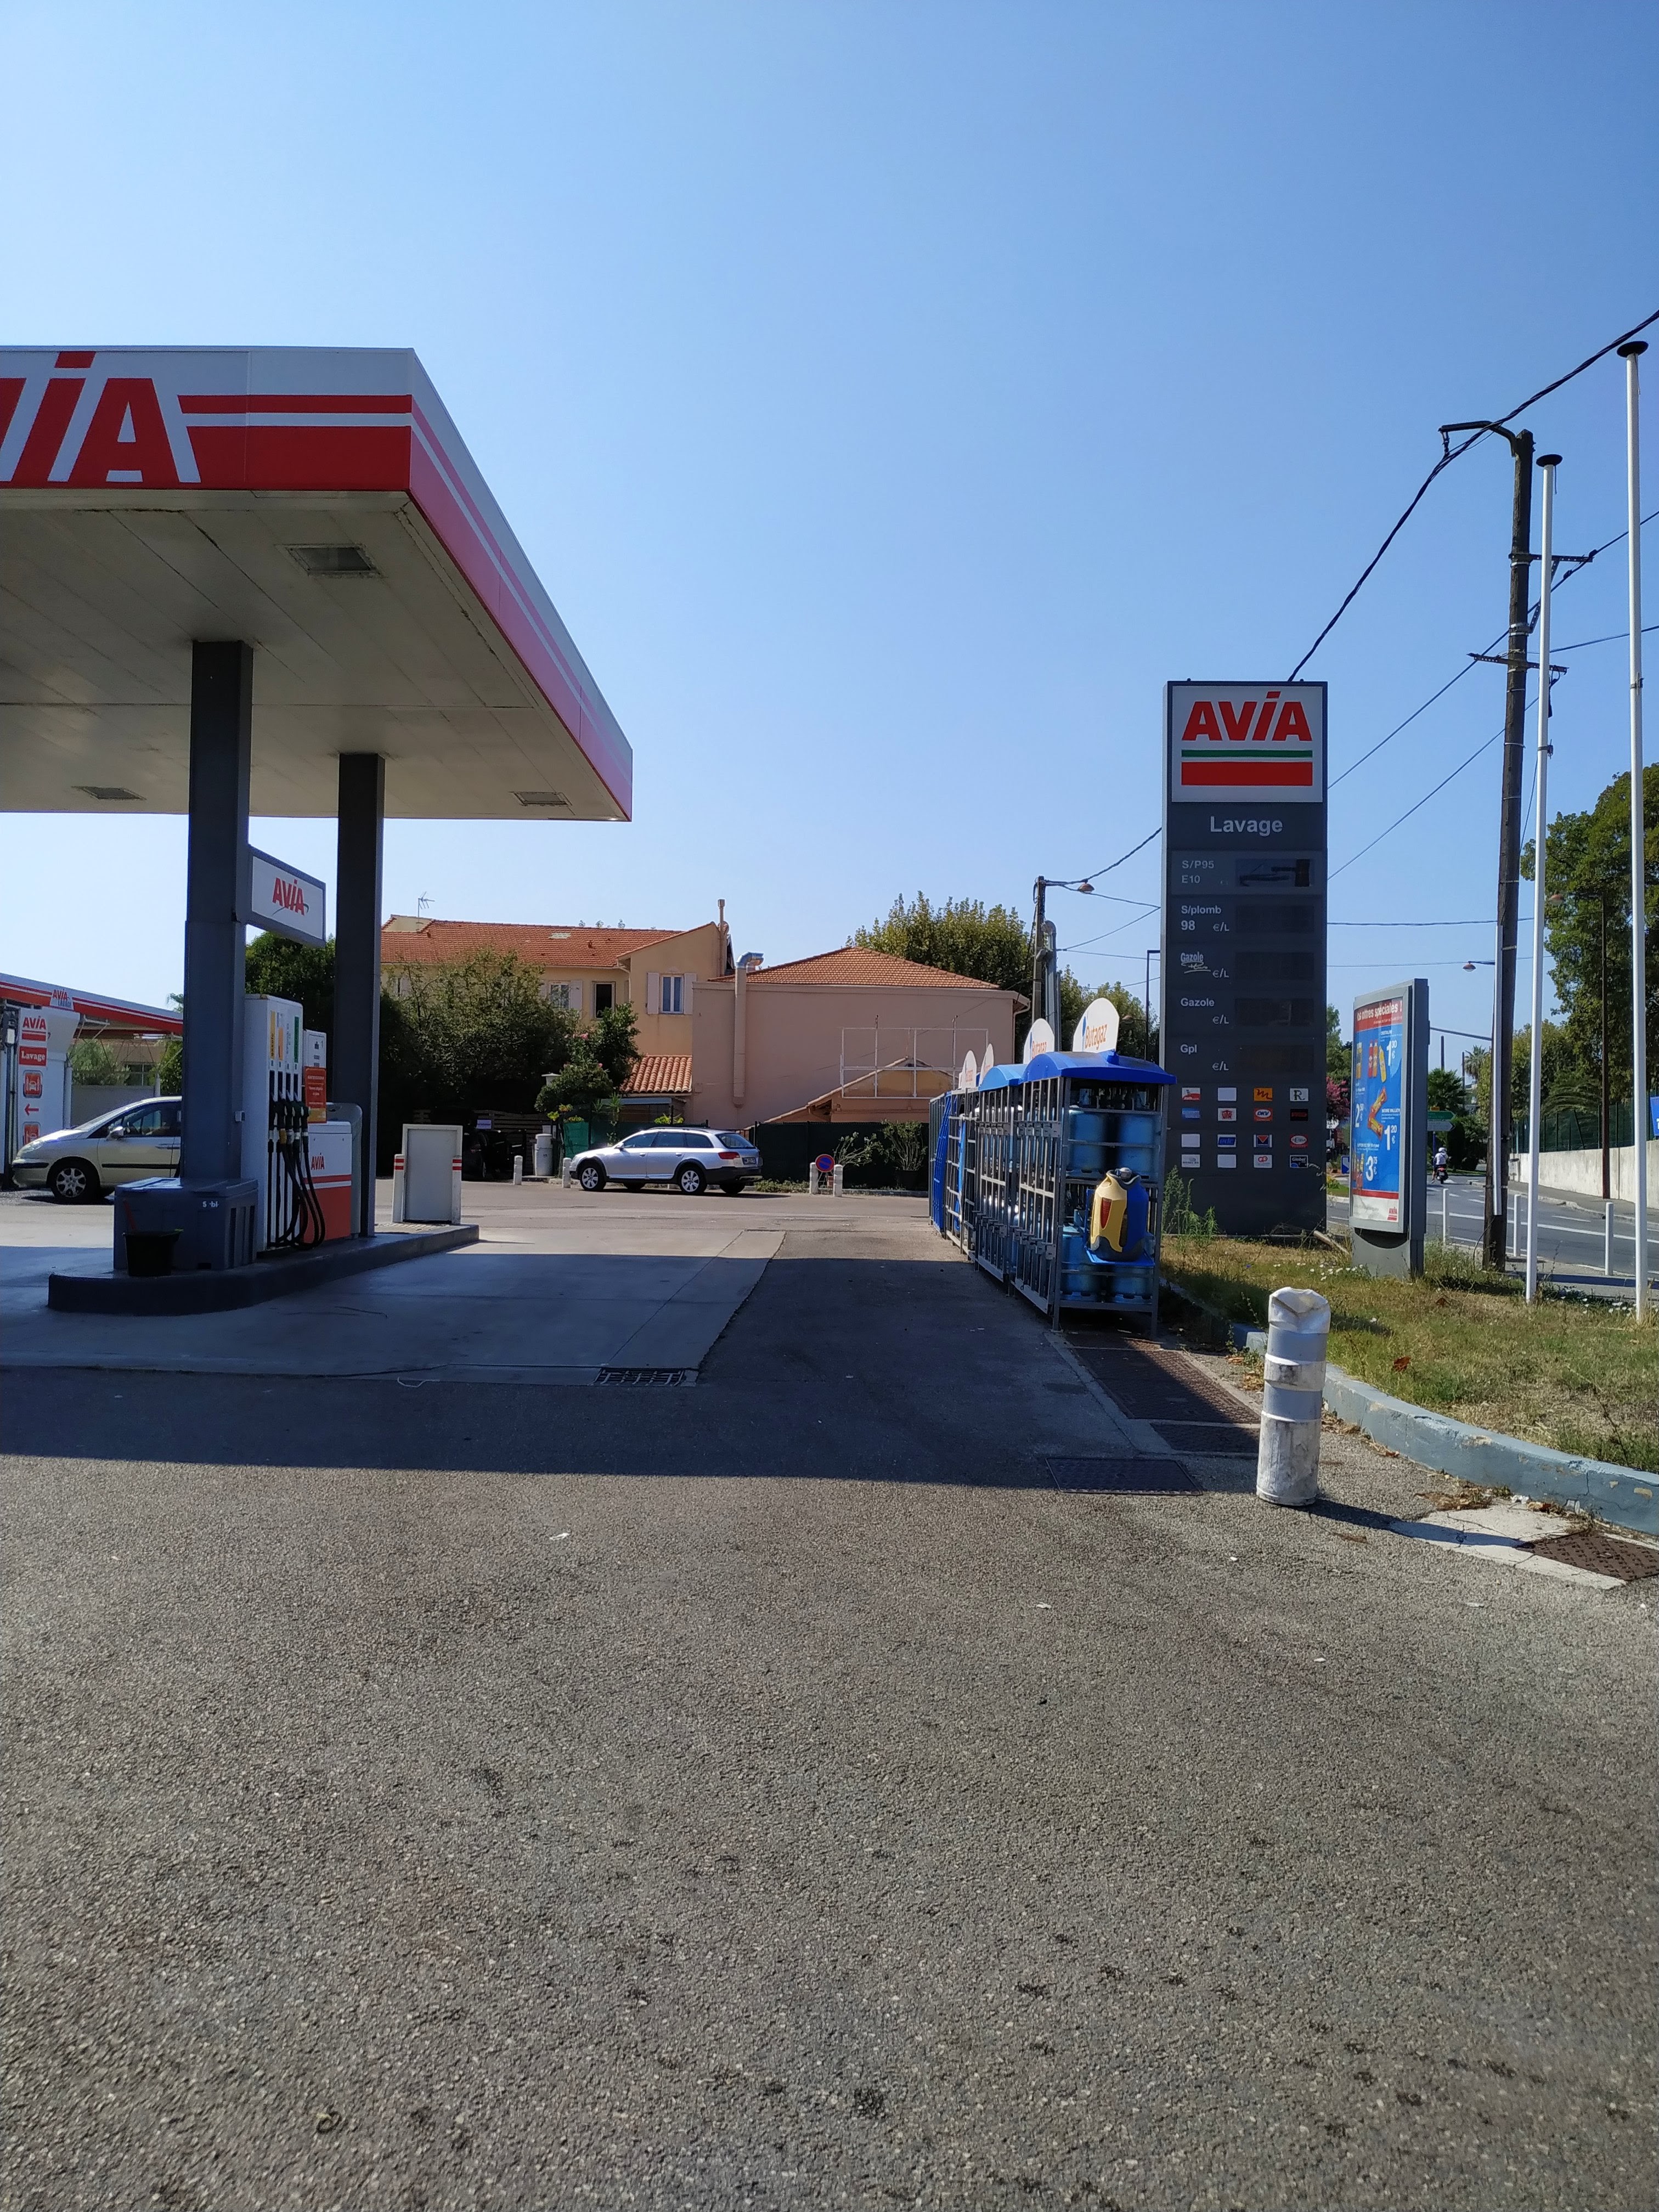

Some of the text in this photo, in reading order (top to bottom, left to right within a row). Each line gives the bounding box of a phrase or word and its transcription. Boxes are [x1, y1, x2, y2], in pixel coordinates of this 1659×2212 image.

[1210, 816, 1283, 836] Lavage
[1182, 860, 1215, 869] S/P95
[1182, 874, 1200, 884] E10
[1181, 905, 1222, 916] S/plomb
[1181, 920, 1229, 932] 98 €/L
[1181, 951, 1204, 962] Gazole
[1212, 968, 1229, 978] €/L
[1181, 997, 1215, 1007] Gazole
[1212, 1014, 1229, 1024] €/L
[1085, 1024, 1108, 1050] Butagaz
[1180, 1044, 1198, 1054] Gpl
[21, 1050, 46, 1063] Lavage
[1212, 1060, 1229, 1071] €/L
[1355, 1103, 1360, 1128] 2
[1384, 1125, 1391, 1150] 1
[1391, 1125, 1397, 1133] 20
[1365, 1155, 1374, 1181] 3
